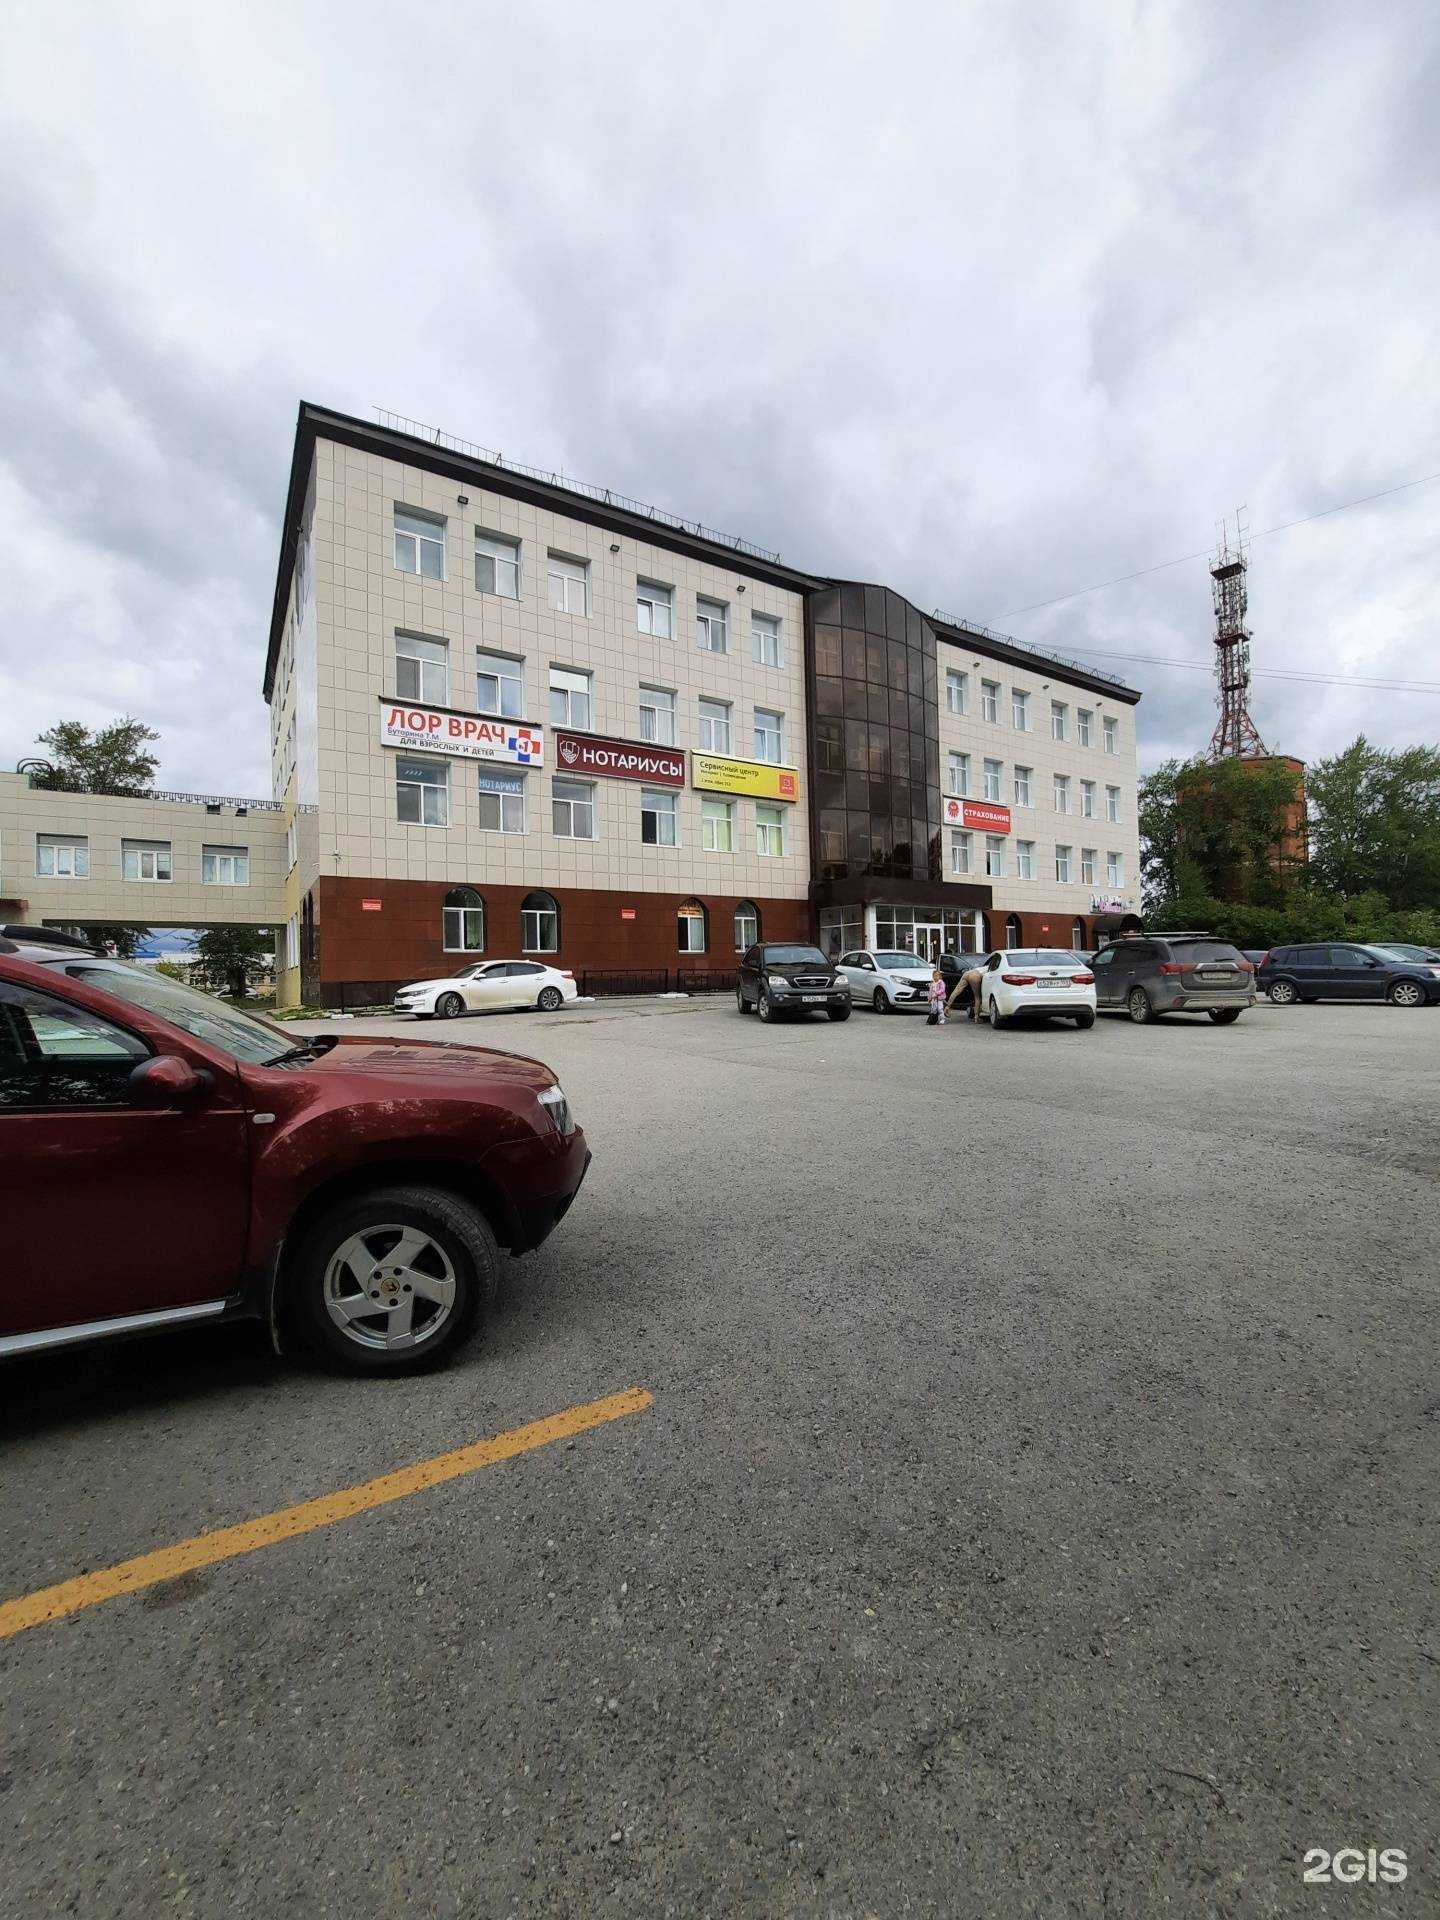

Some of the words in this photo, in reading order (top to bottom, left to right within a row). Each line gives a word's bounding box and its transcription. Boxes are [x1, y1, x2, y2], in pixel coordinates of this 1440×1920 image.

[388, 708, 442, 733] ЛОР
[448, 718, 506, 745] ВРАЧ
[583, 747, 683, 777] НОТАРИУСЫ
[700, 760, 739, 774] Сервисный
[739, 768, 760, 778] центр
[479, 778, 522, 792] НОТАРИУС
[964, 808, 1010, 823] СТРАХОВАНИЕ
